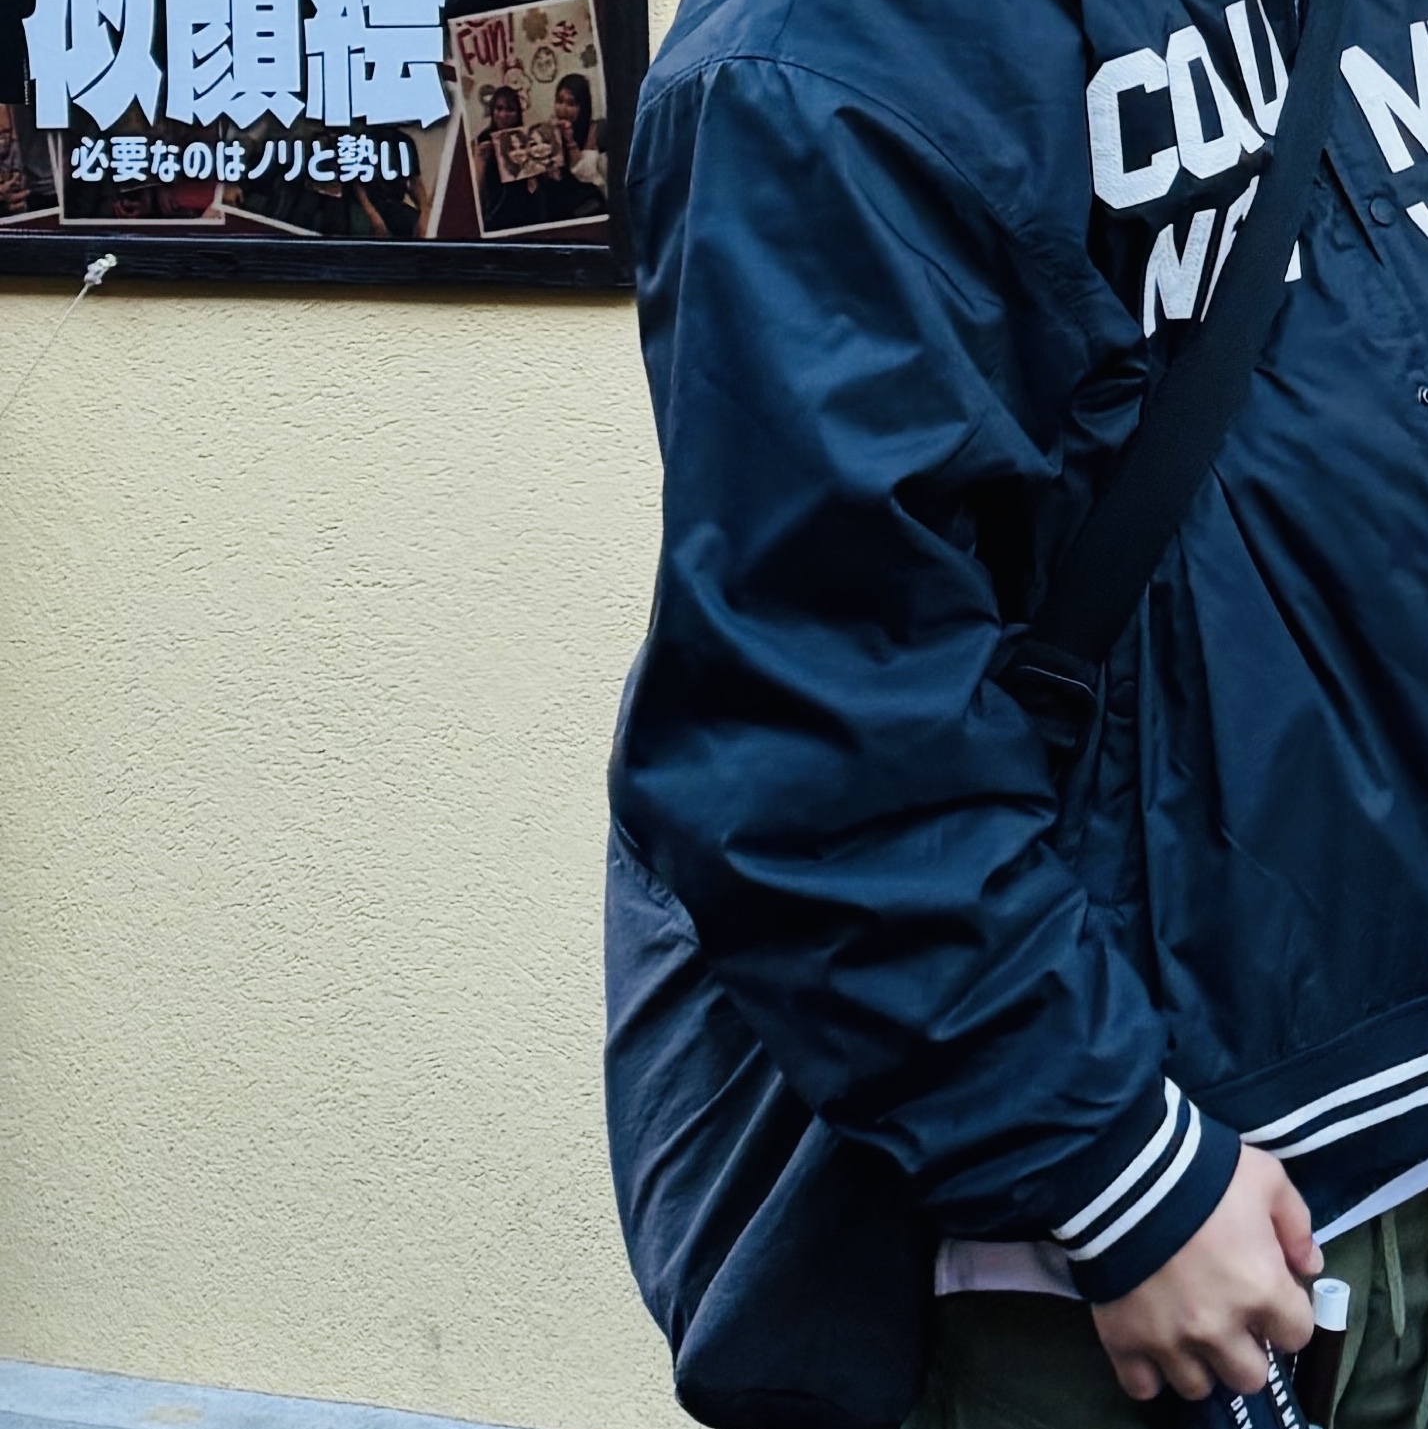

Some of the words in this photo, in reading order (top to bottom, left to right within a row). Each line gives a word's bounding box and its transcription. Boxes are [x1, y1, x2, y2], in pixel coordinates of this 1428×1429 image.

[70, 134, 412, 183] 必要なのはノリと勢い
